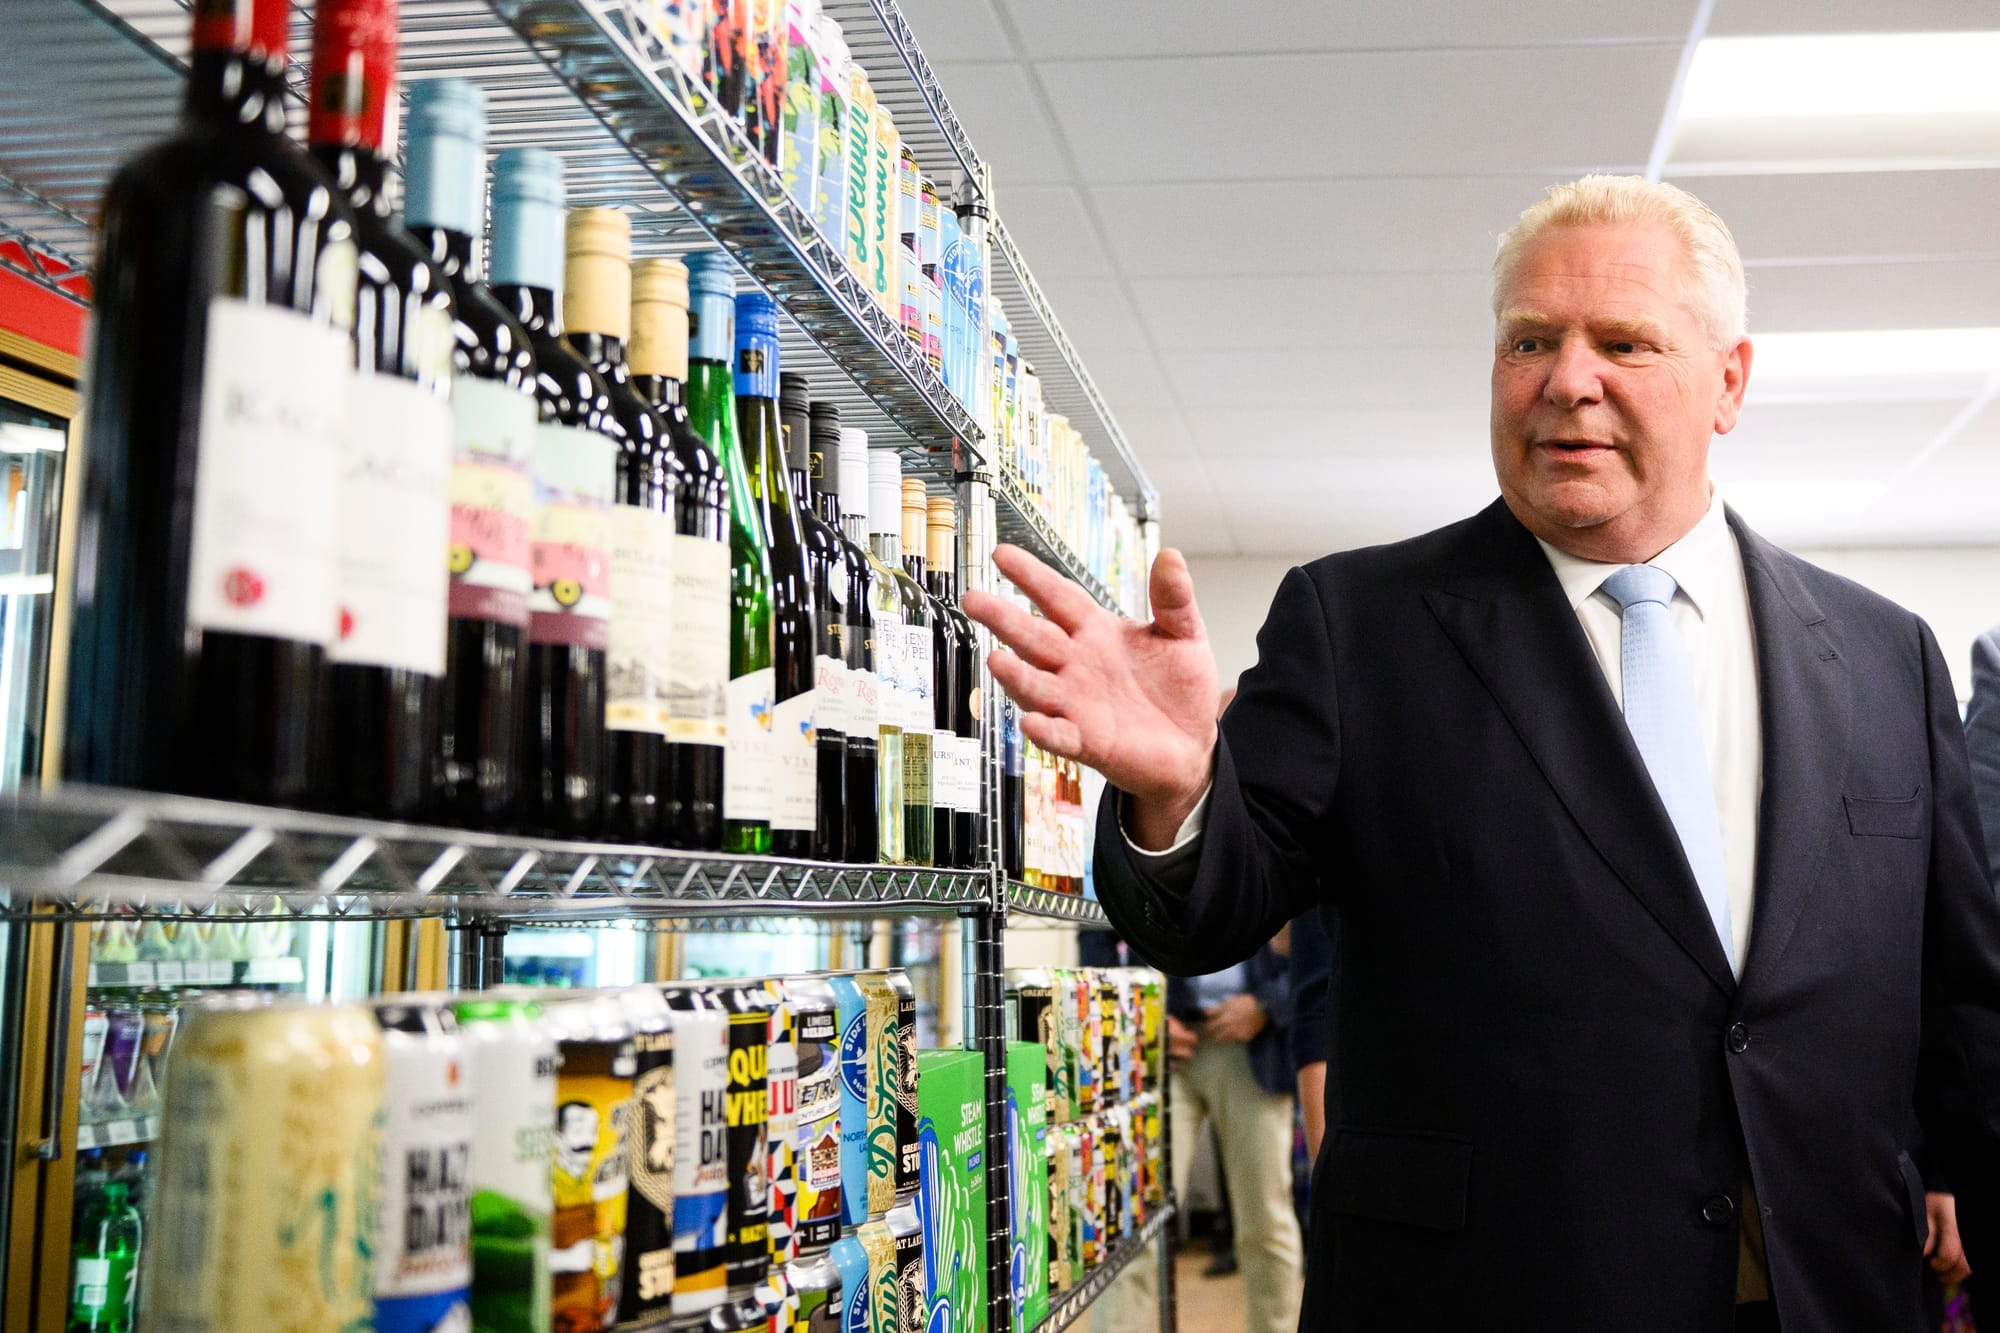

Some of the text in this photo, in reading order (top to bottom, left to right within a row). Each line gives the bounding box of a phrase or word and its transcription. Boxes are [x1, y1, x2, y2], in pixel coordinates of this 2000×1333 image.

[845, 1022, 862, 1051] SIDE
[960, 1100, 982, 1128] STEAM
[954, 1123, 983, 1156] WHISTLE
